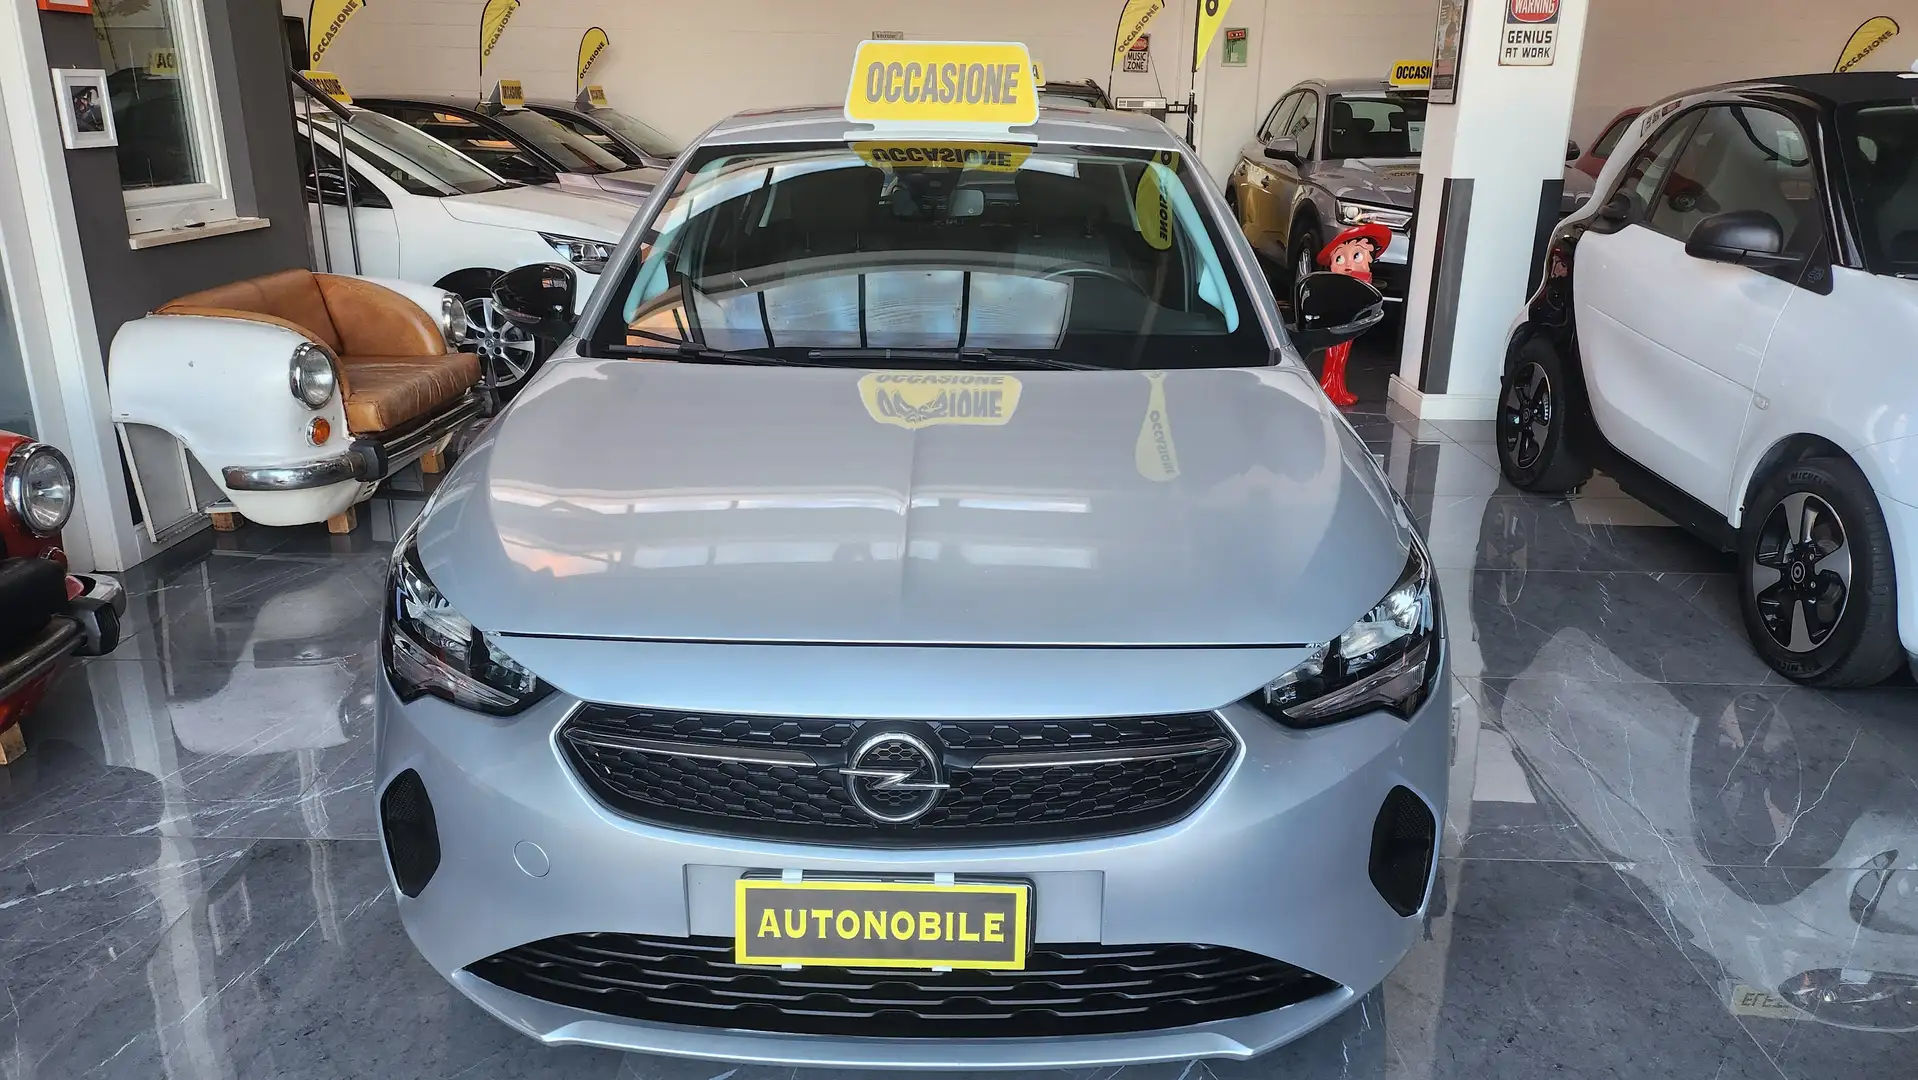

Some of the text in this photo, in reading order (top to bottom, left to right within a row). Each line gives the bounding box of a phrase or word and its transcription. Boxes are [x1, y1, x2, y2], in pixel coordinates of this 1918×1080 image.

[313, 0, 358, 62] OCCASIONE
[484, 5, 515, 57] OCCASIONE
[1117, 4, 1159, 53] OCCASIONE
[1508, 30, 1553, 44] GENIUS
[579, 41, 605, 79] OCCASIONE
[1127, 52, 1147, 61] MUSIC
[1127, 61, 1144, 70] ZONE
[1505, 47, 1551, 58] AT WORK
[1839, 30, 1893, 73] OCCASIONE
[866, 61, 1020, 105] OCCASIONE
[757, 908, 1006, 943] AUTONOBILE
